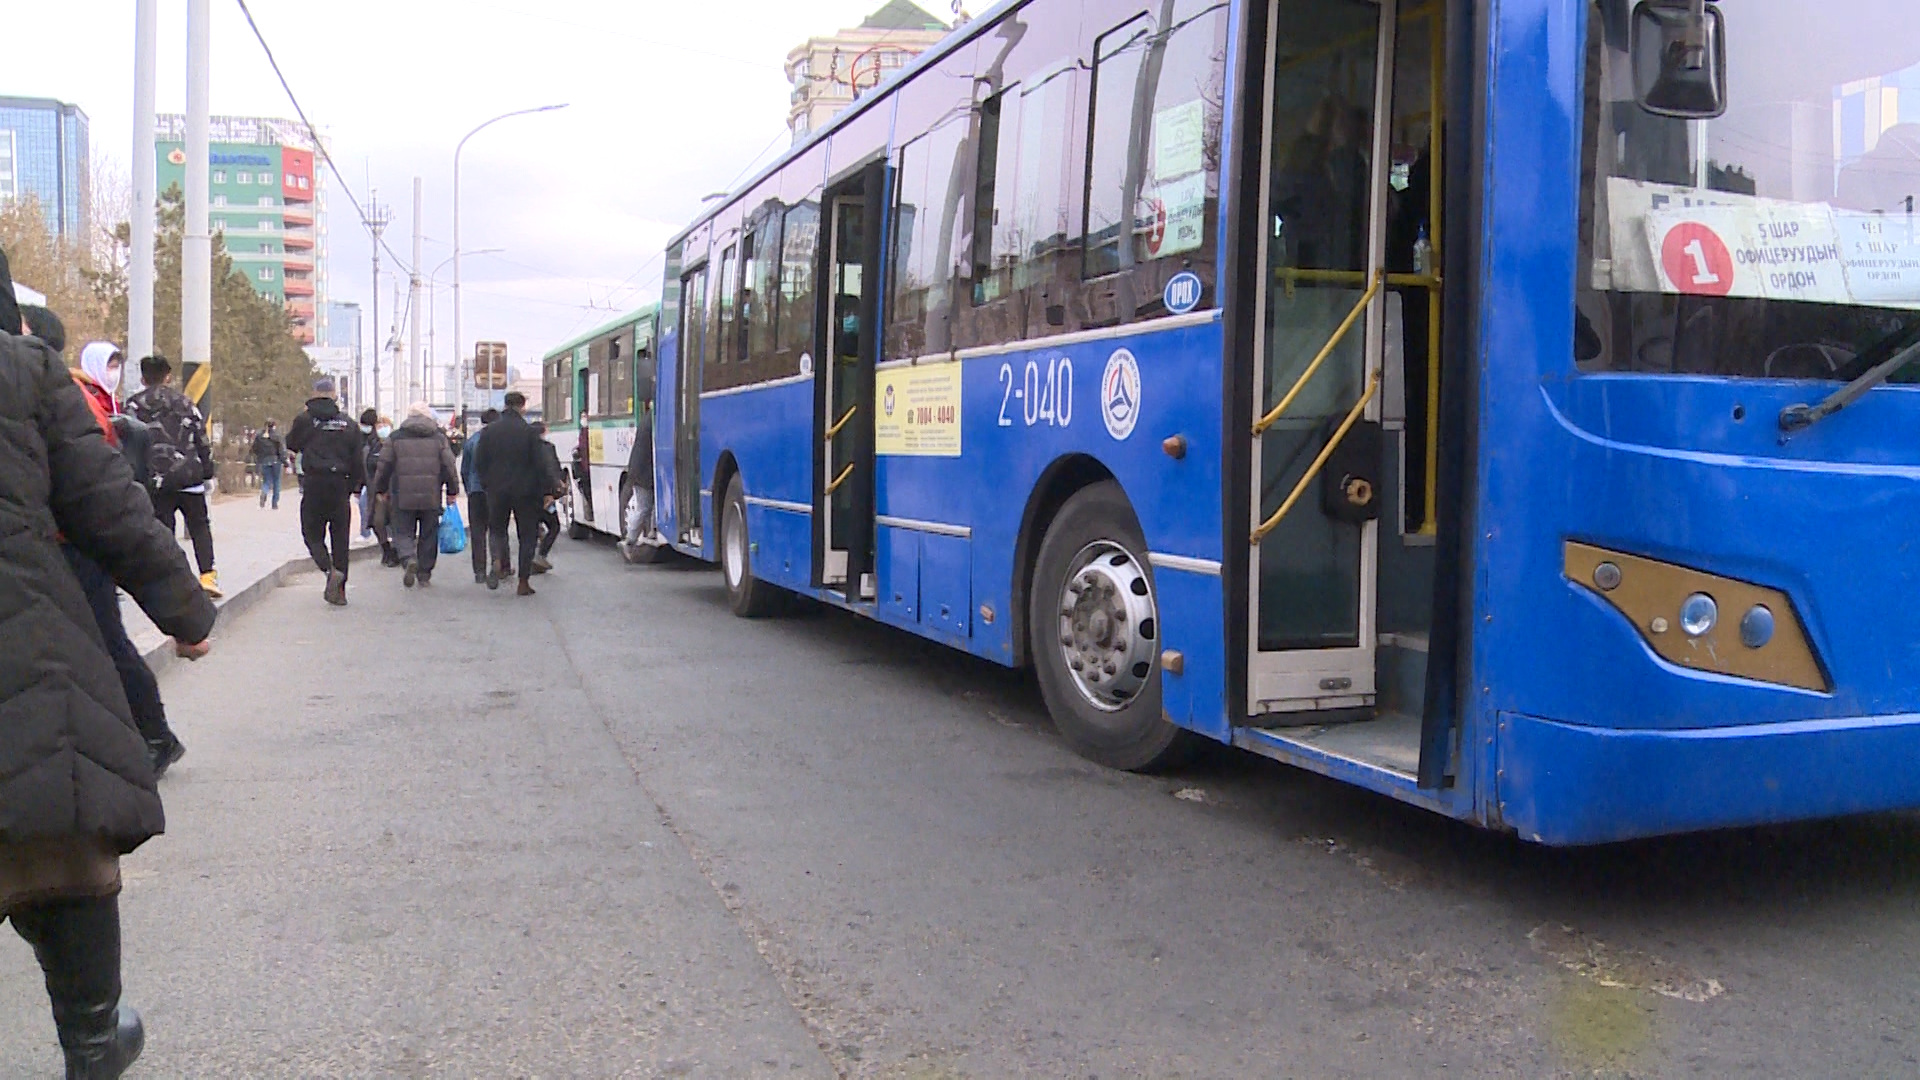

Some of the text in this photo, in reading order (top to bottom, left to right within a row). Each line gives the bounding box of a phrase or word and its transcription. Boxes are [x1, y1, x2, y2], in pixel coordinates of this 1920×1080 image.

[1758, 221, 1799, 238] 5 ШАР
[1736, 243, 1838, 266] ОФИЦЕРУУДЫН
[1868, 241, 1898, 253] ШАР
[1683, 239, 1719, 285] 1
[1770, 271, 1817, 291] ОРДОН
[998, 358, 1073, 427] 2-040
